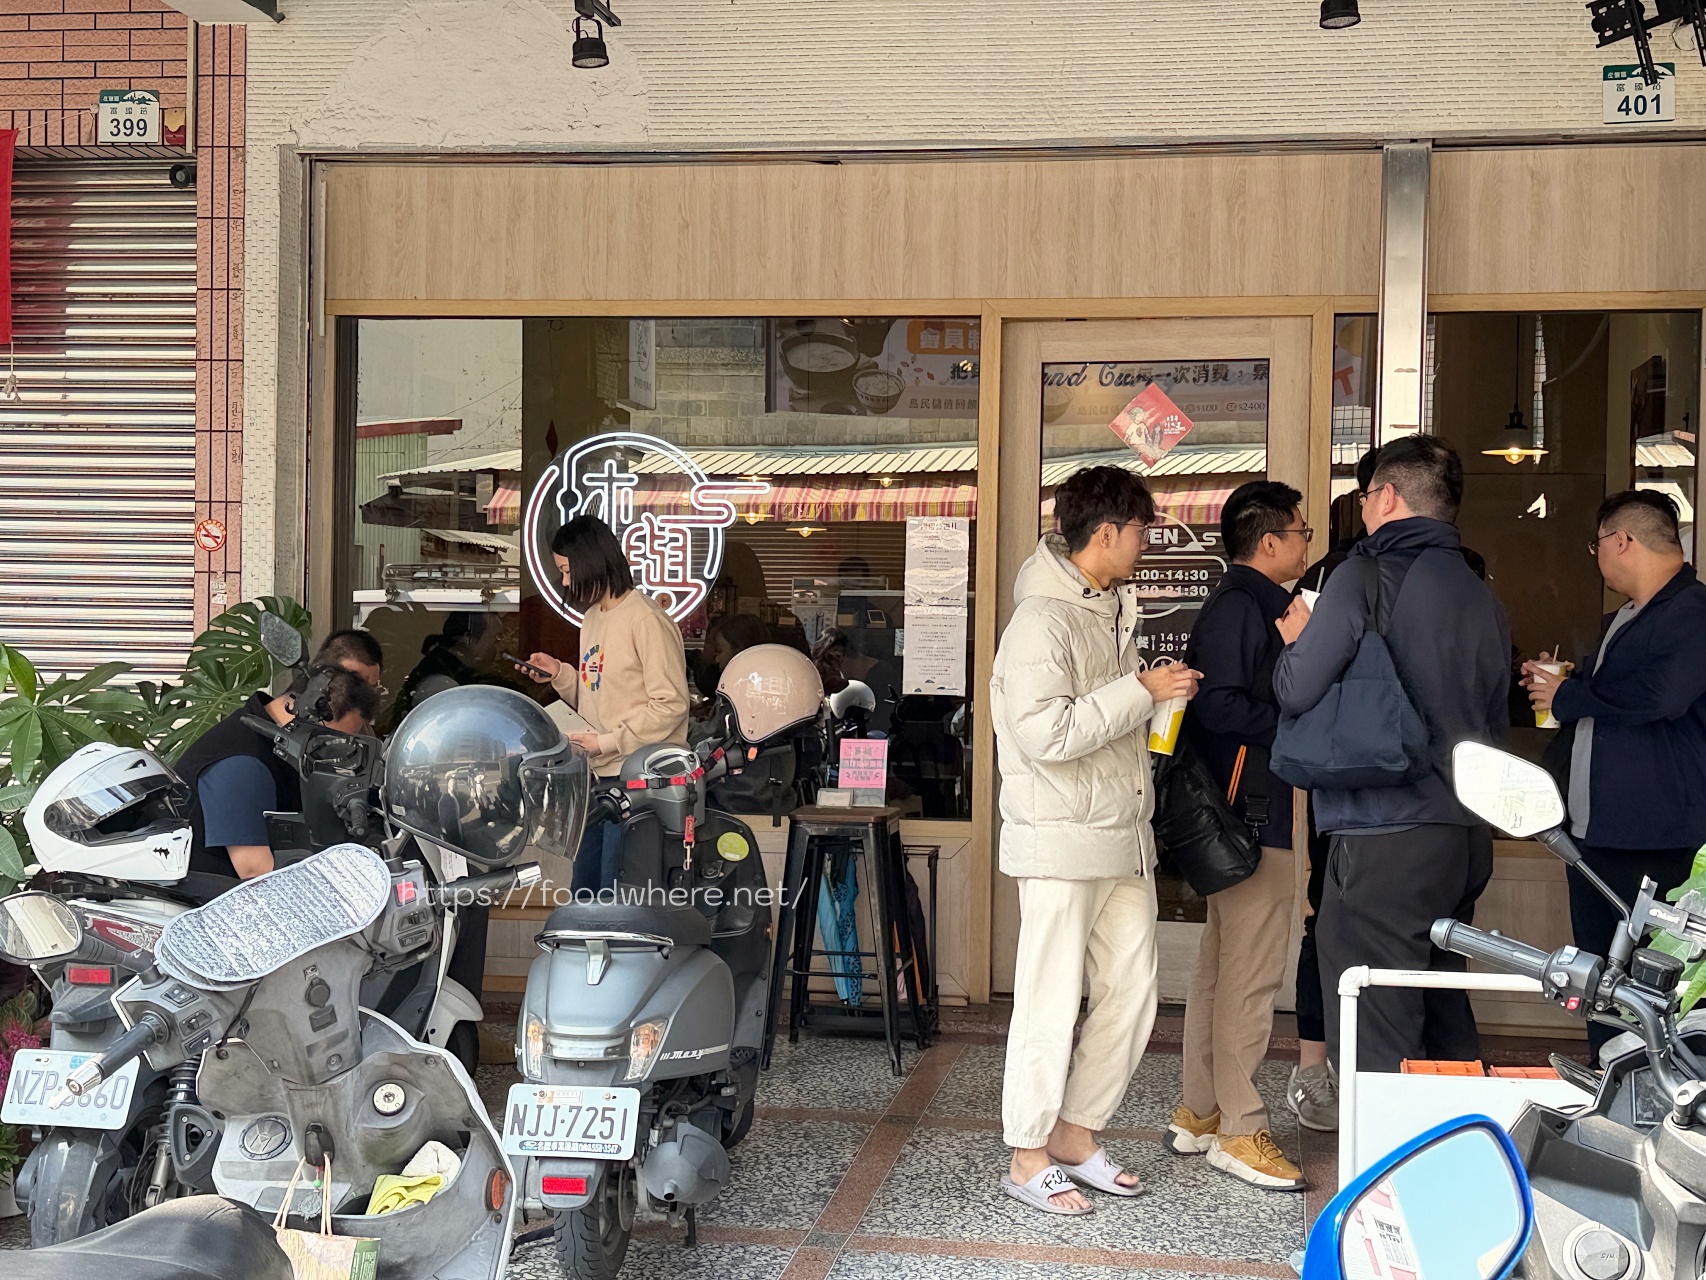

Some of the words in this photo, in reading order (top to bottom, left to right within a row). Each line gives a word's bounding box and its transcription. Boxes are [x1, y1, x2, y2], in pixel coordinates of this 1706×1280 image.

[1617, 94, 1661, 116] 401
[110, 118, 148, 137] 399
[1160, 632, 1191, 642] 14:0
[1160, 643, 1188, 652] 20:4
